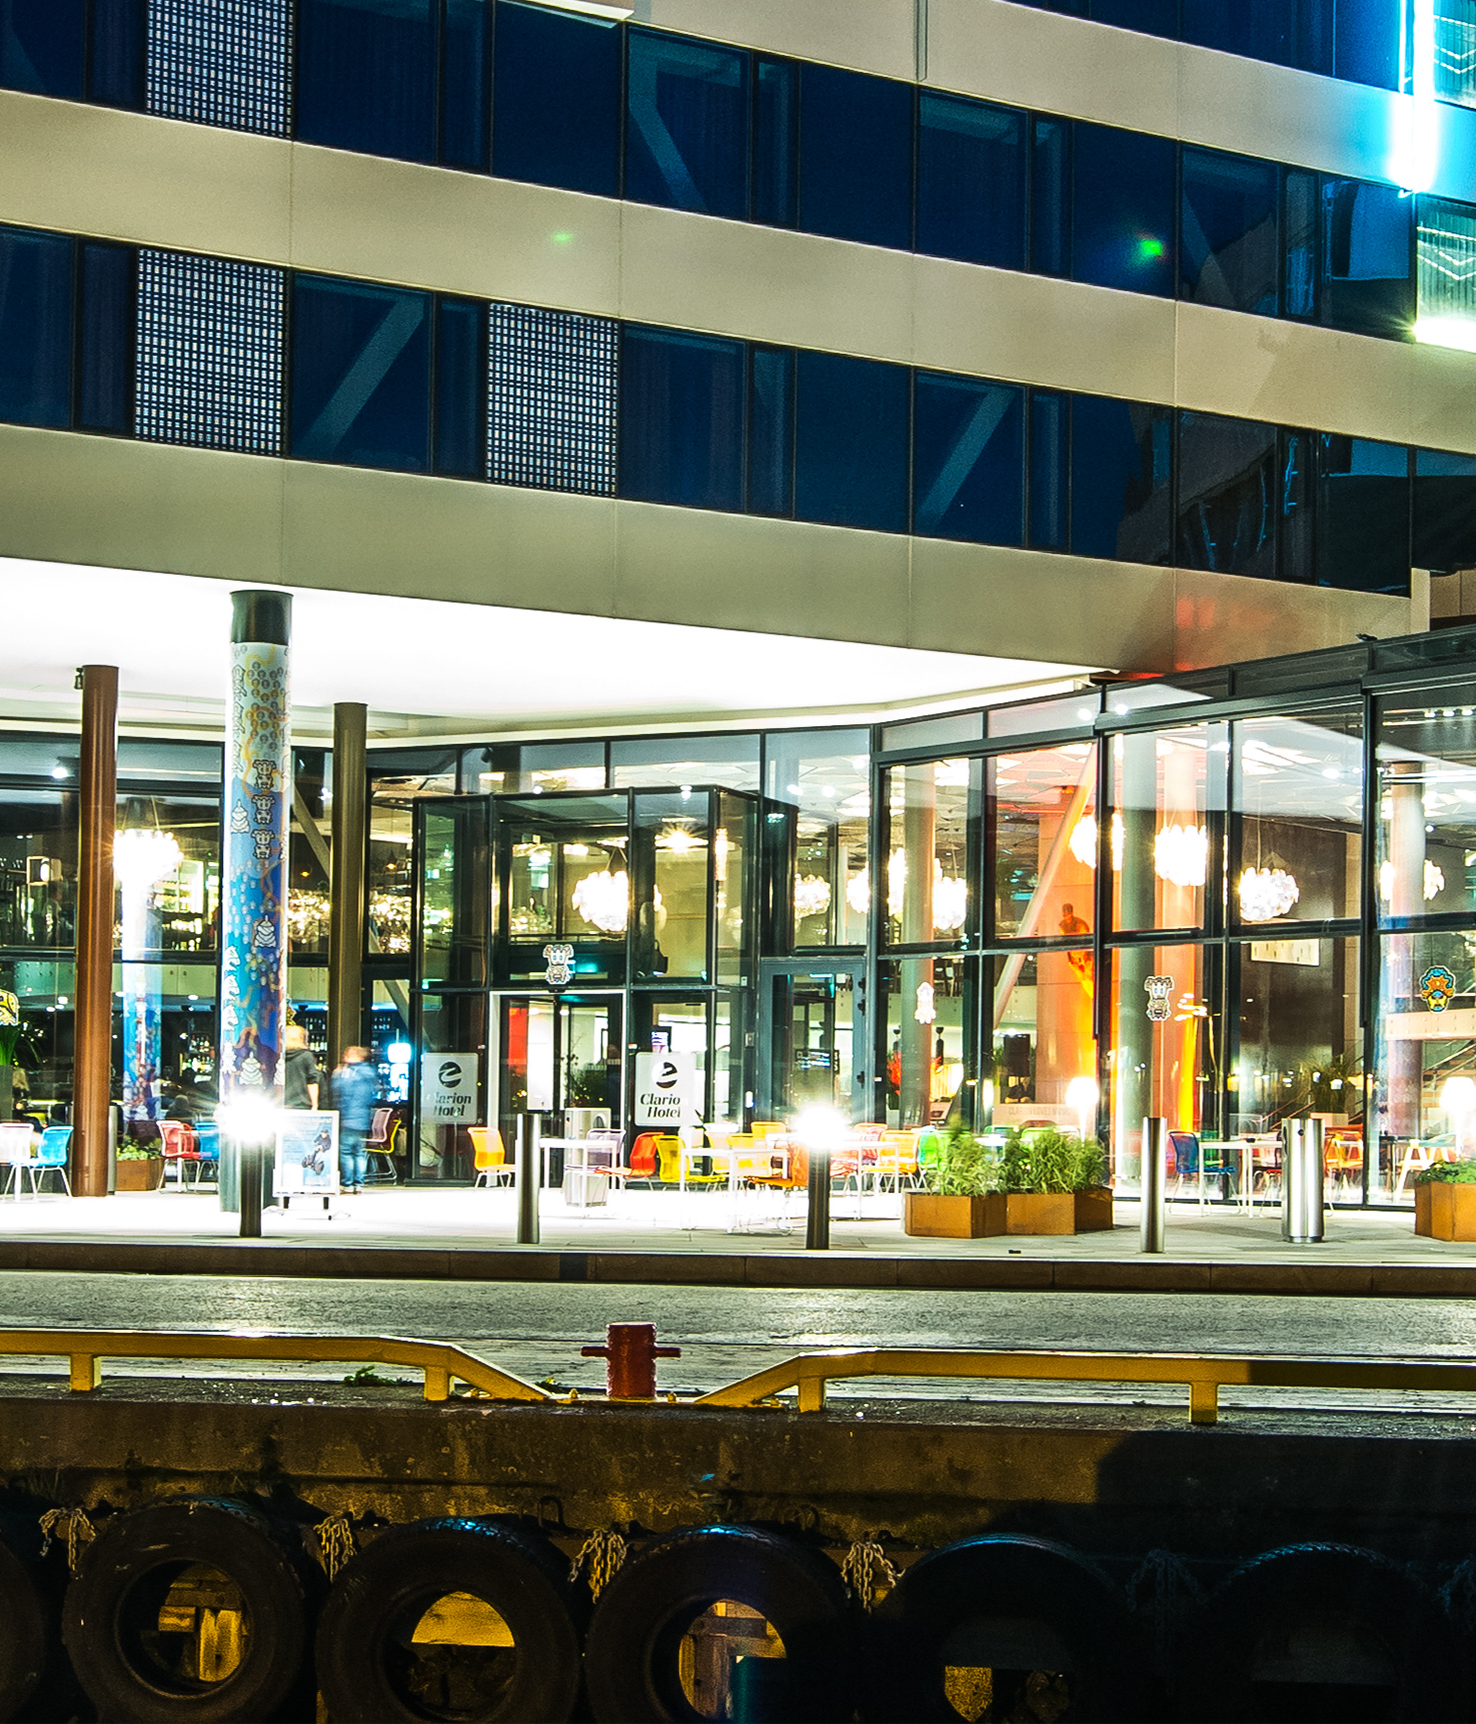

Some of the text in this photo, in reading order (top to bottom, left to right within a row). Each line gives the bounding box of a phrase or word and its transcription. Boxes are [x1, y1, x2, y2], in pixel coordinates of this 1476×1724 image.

[430, 1090, 472, 1105] larion
[639, 1092, 682, 1106] Clario
[646, 1105, 682, 1119] Hotel
